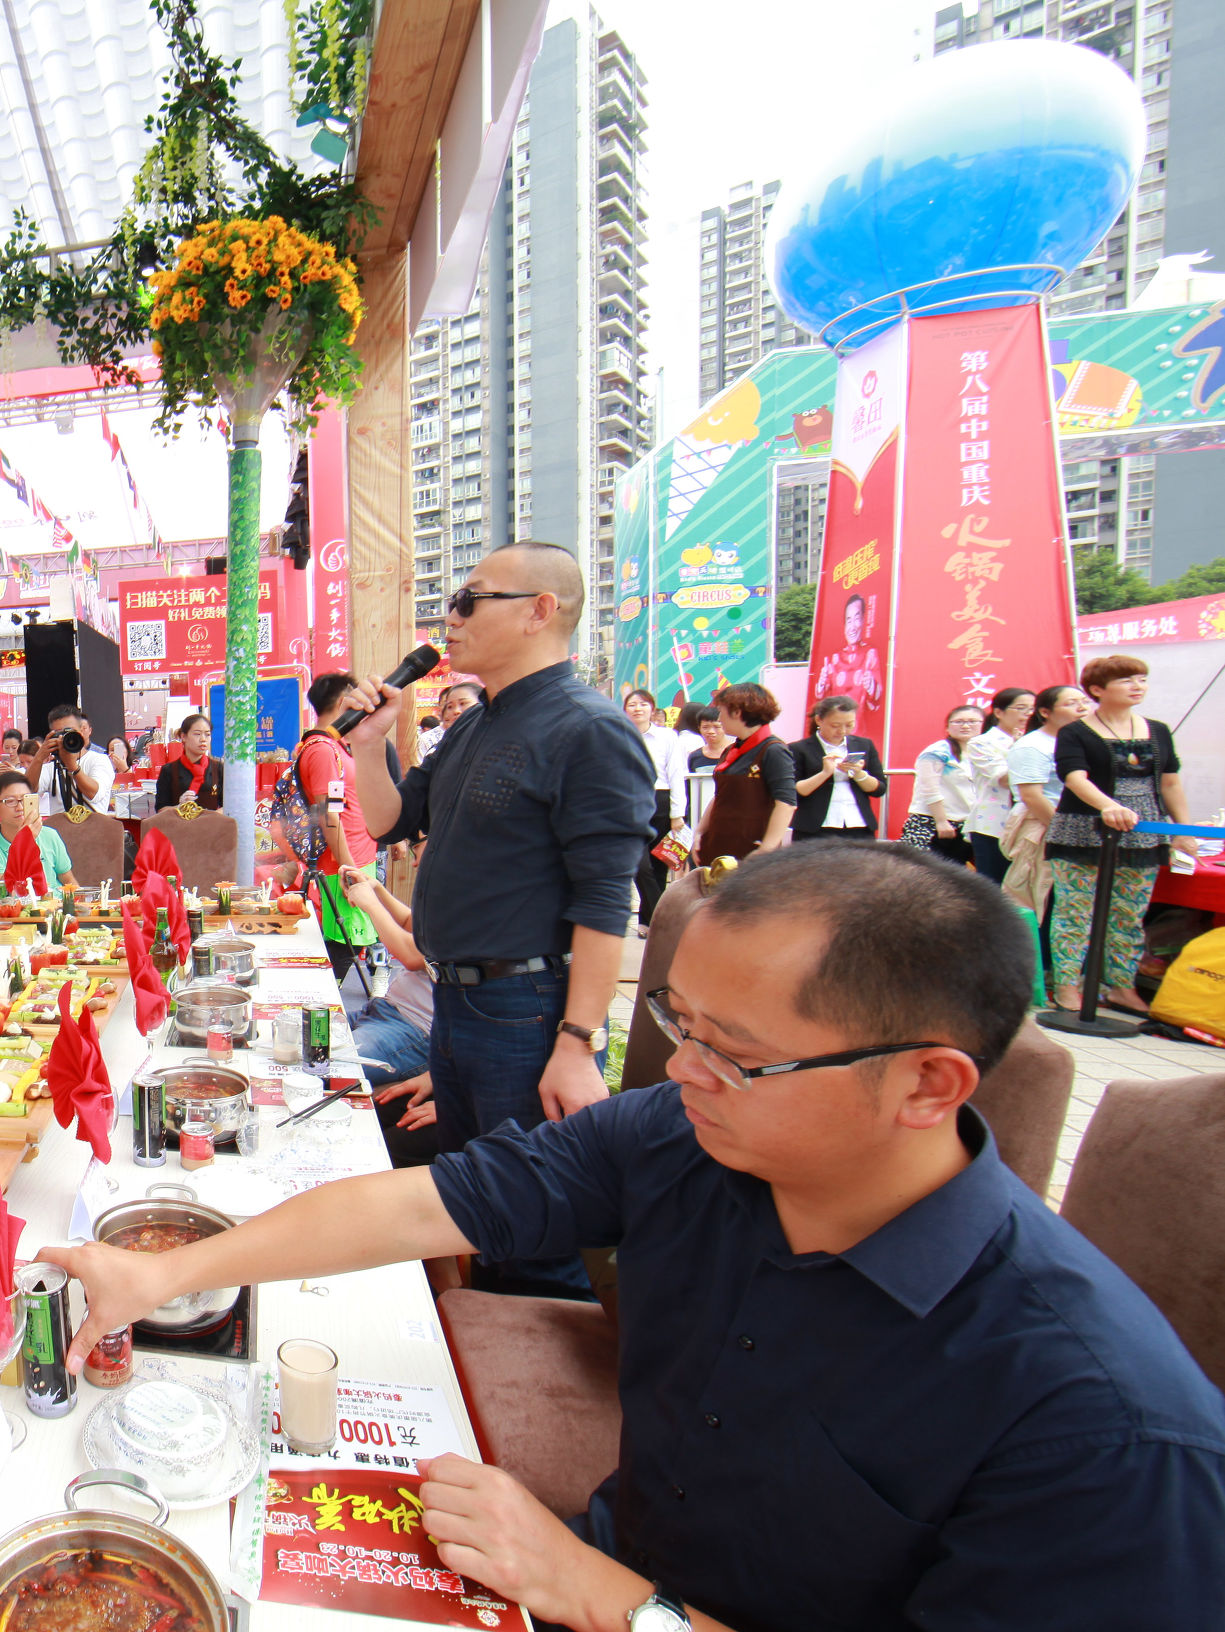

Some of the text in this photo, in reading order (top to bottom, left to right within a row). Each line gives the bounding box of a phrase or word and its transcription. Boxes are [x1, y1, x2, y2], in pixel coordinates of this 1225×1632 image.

[690, 589, 732, 603] CIRCUS
[134, 661, 161, 672] 订阅号
